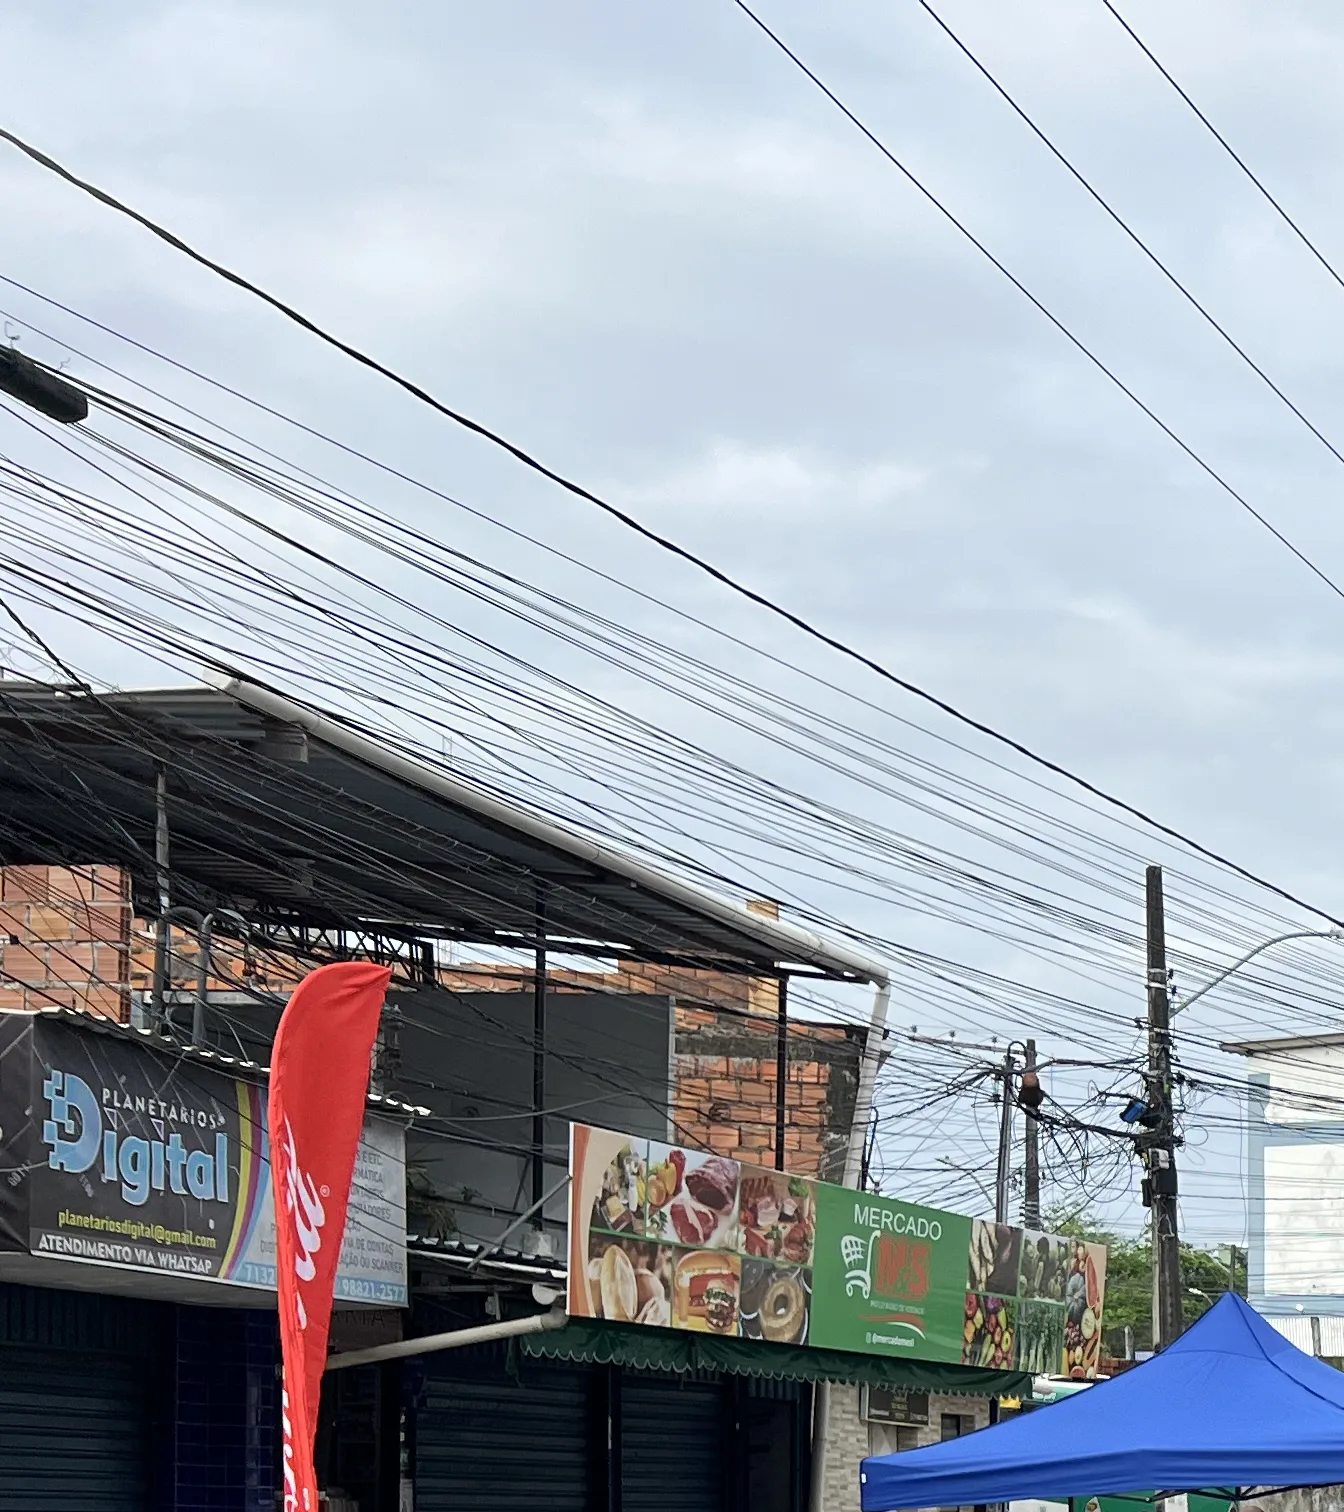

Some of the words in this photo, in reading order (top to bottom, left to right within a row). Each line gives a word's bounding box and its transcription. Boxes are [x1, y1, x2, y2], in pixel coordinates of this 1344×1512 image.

[43, 1068, 229, 1206] Digital
[854, 1203, 943, 1241] MERCADO
[38, 1233, 133, 1262] ATENDIMENTO
[134, 1247, 156, 1267] VIA
